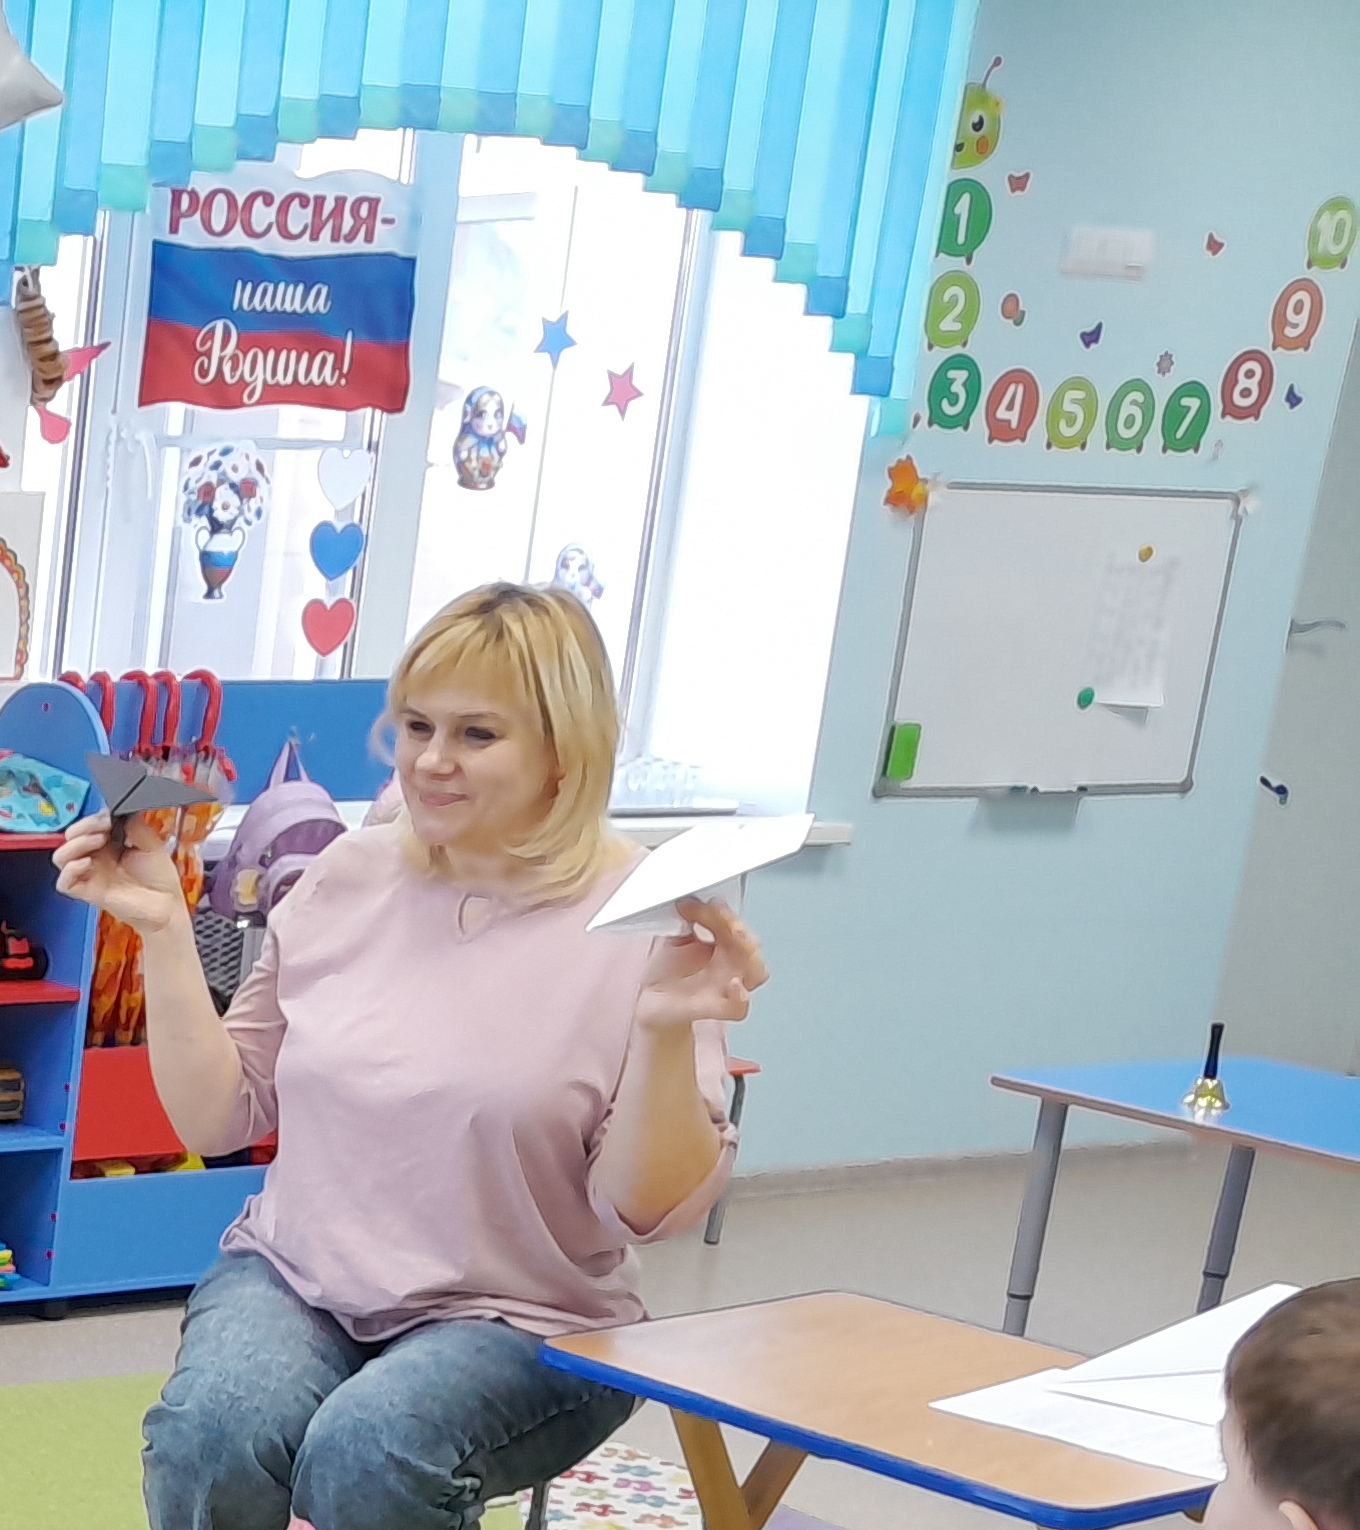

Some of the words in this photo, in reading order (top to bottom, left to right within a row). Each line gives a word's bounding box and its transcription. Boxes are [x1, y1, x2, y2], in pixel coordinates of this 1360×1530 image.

[953, 191, 971, 246] 1
[1316, 208, 1354, 256] 10
[232, 279, 332, 314] наша
[938, 285, 967, 333] 2
[1282, 290, 1312, 340] 9
[193, 318, 354, 405] Родина!
[1232, 359, 1263, 408] 8
[940, 369, 969, 417] 3
[995, 382, 1025, 430] 4
[1058, 390, 1087, 438] 5
[1117, 391, 1145, 439] 6
[1176, 396, 1203, 441] 7
